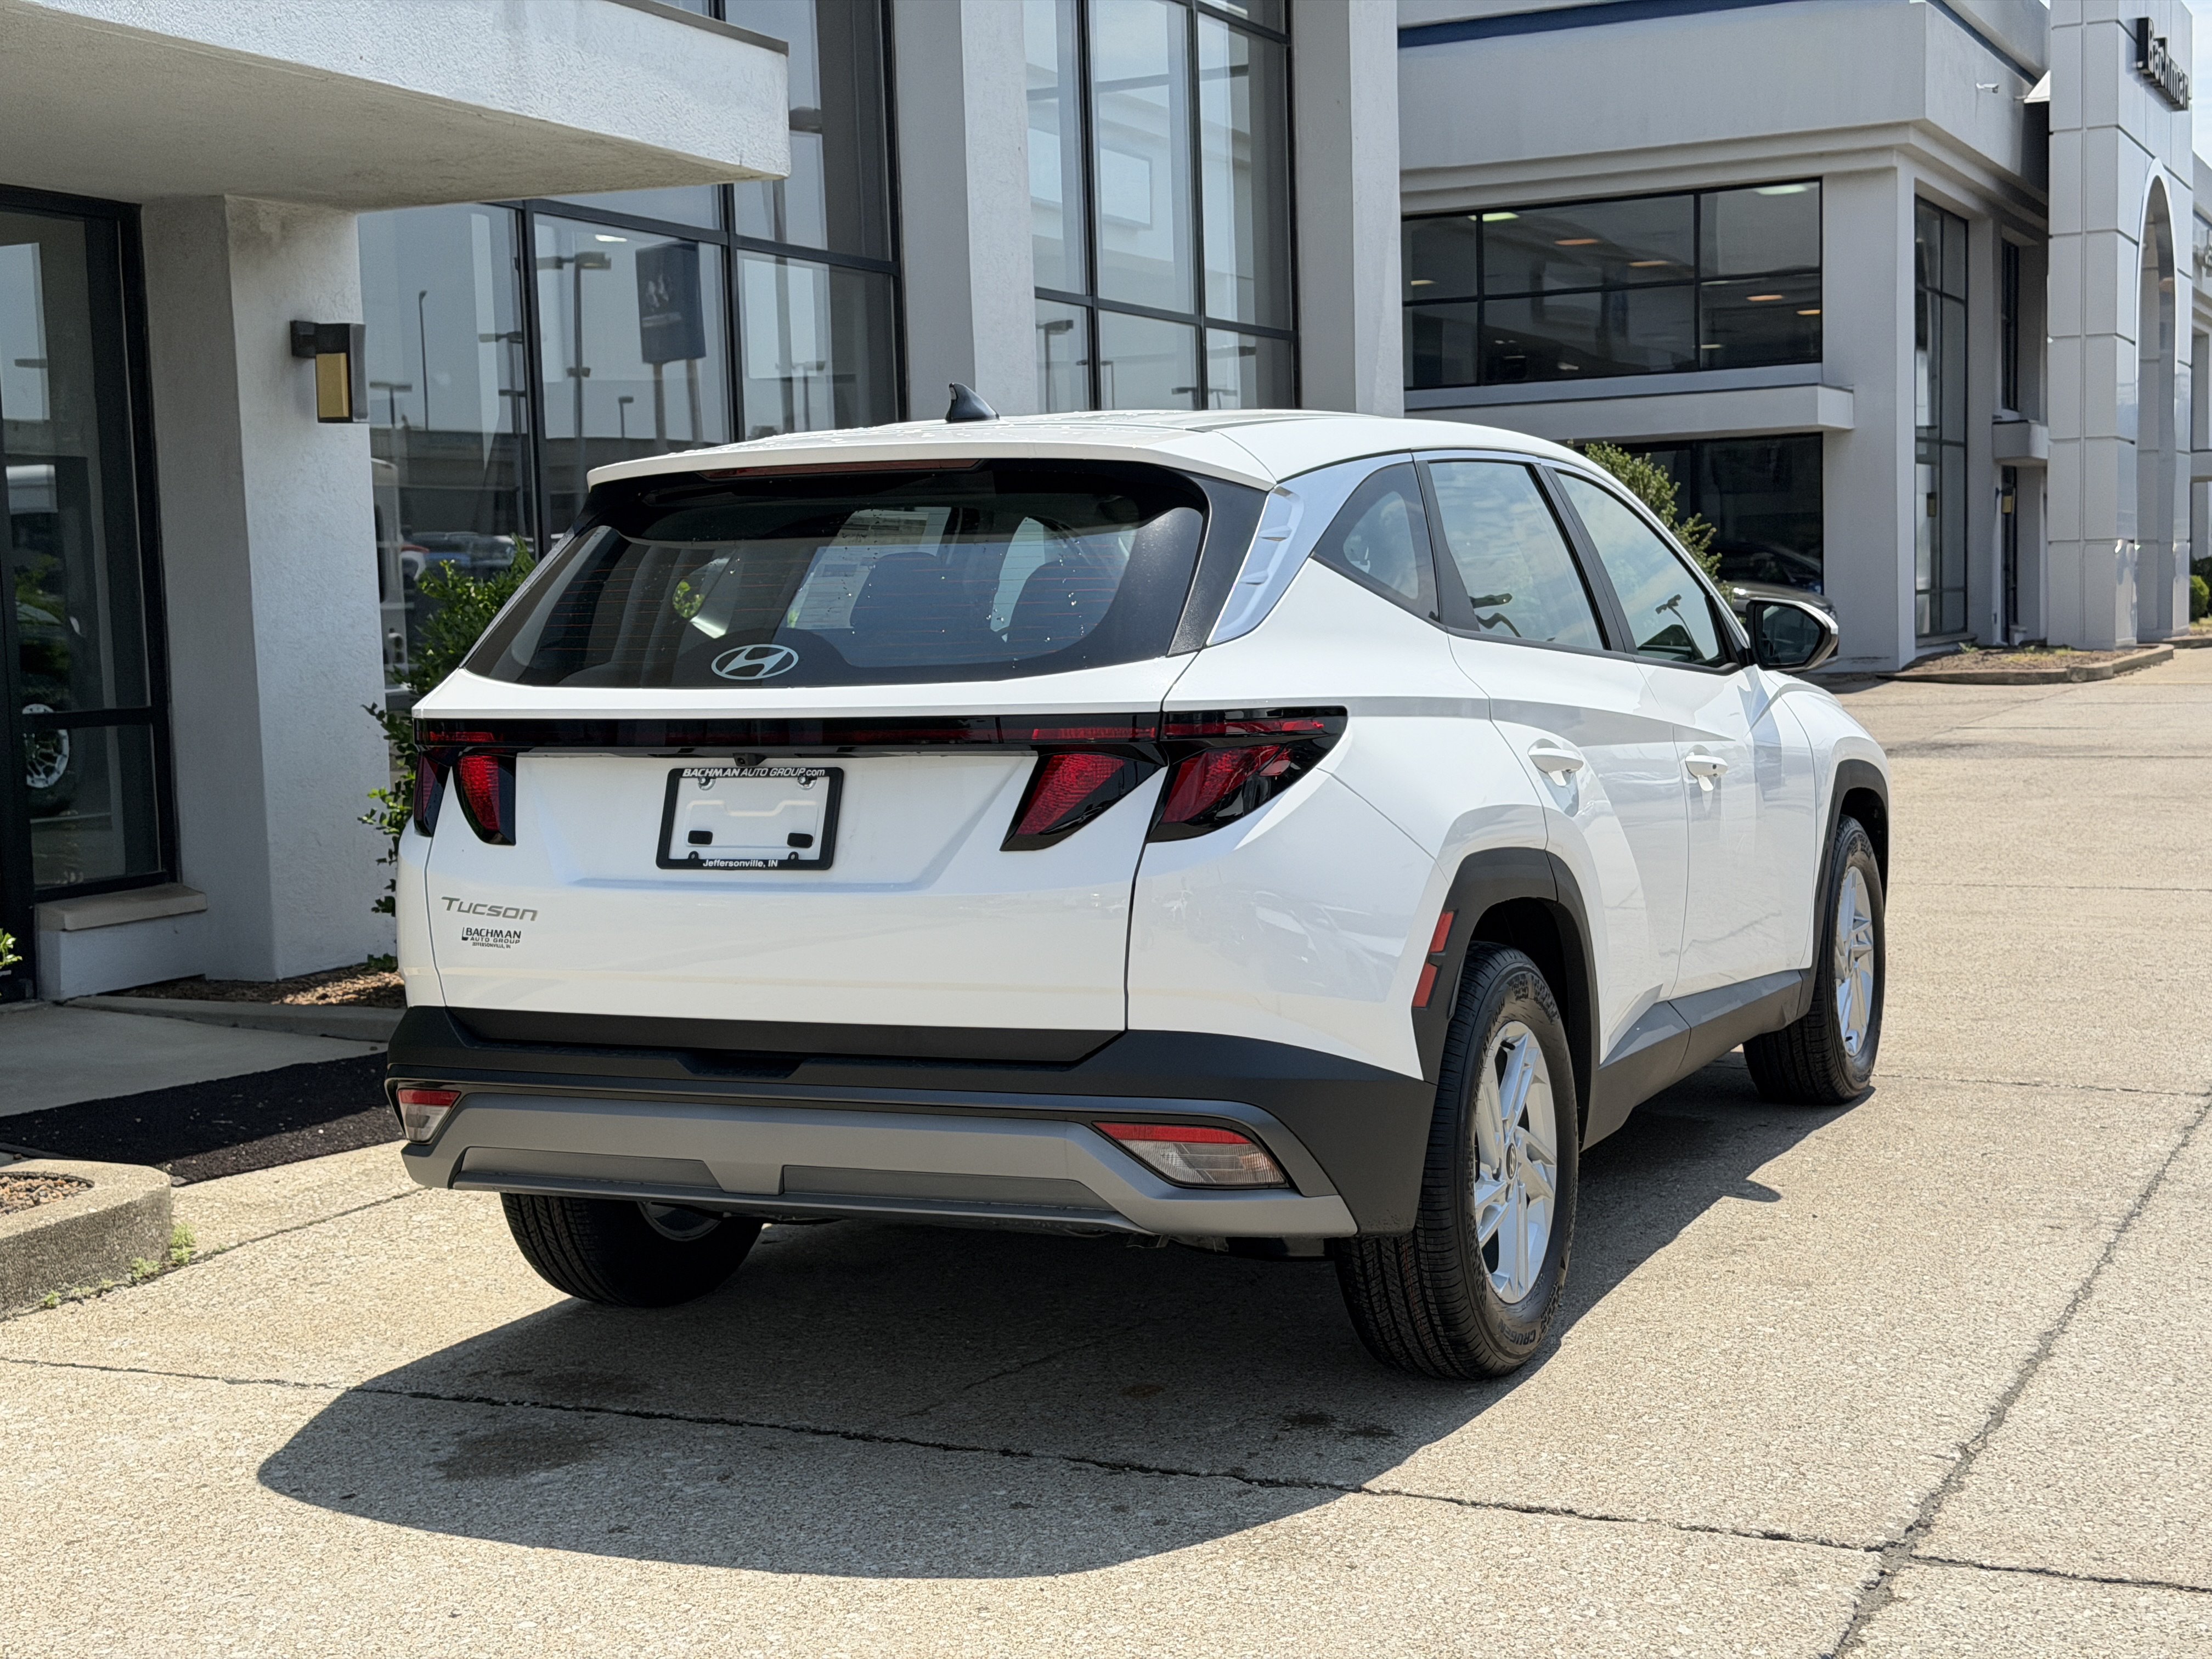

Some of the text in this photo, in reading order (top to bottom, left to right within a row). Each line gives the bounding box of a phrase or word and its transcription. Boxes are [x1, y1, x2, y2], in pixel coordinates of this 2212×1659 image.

[682, 768, 825, 777] BACHMAN AUTO GROUP.com
[703, 859, 766, 868] Jeffersonville,
[466, 927, 521, 939] BACHMAN
